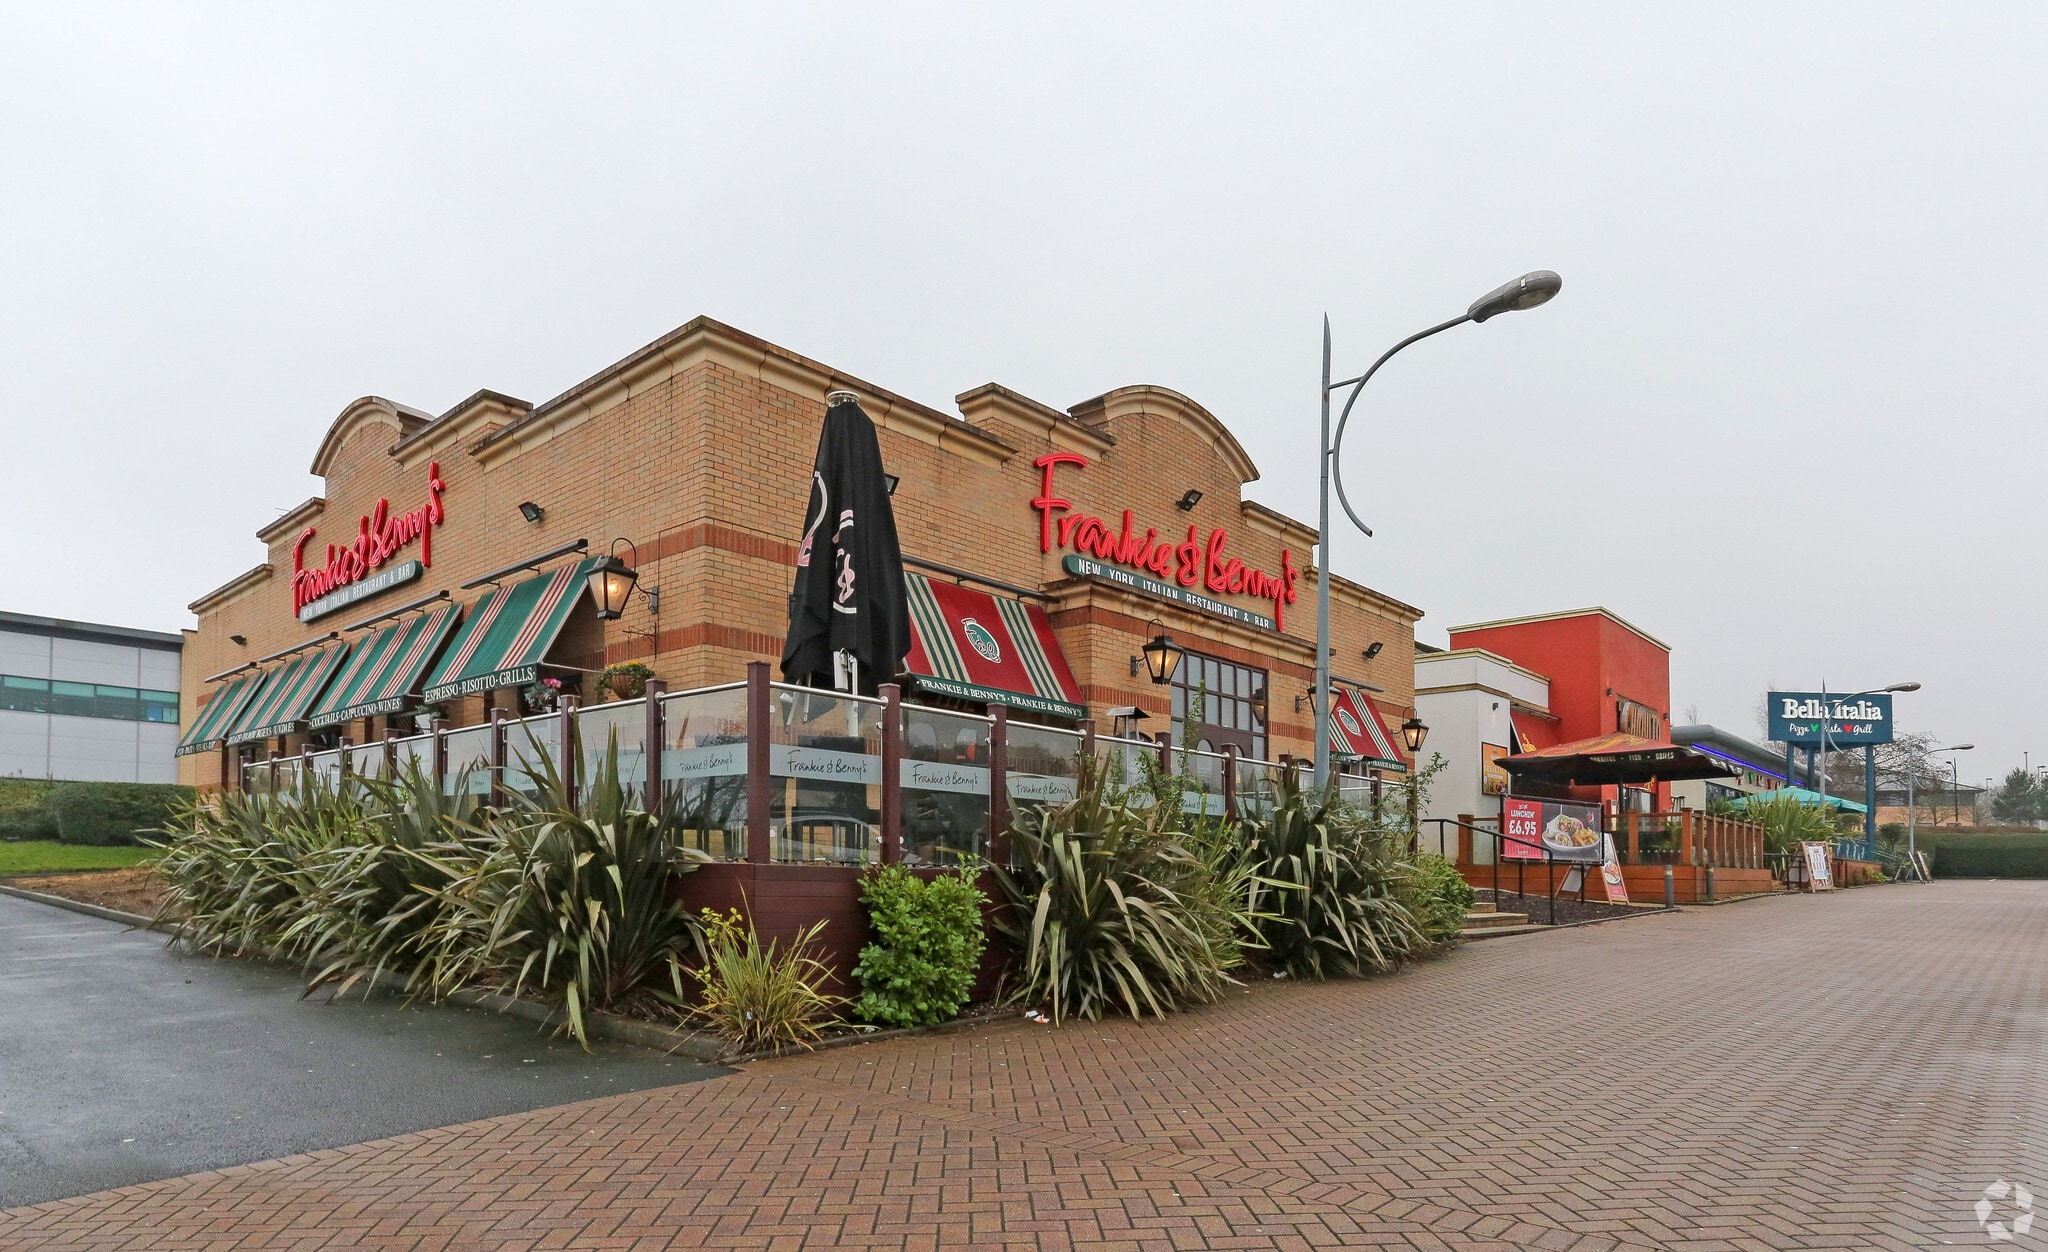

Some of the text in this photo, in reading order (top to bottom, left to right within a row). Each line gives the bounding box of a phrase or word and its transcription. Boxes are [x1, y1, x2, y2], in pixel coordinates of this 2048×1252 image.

[291, 528, 354, 618] Frankie
[369, 462, 445, 568] Benny's
[1031, 453, 1172, 577] Frankie
[1204, 528, 1298, 632] Benny's
[302, 608, 313, 618] NEW
[330, 590, 349, 608] ITALIAN
[352, 573, 387, 598] RESTAURANT
[398, 564, 410, 580] BAR
[1078, 559, 1270, 628] NEW YORK ITALIAN RESTAURANT & BAR
[424, 668, 533, 703] ESPRESSO RISOTTO GRILLS
[920, 678, 962, 694] FRANKIE
[970, 689, 1007, 702] BENNY'S
[1011, 696, 1047, 710] FRANKIE
[1054, 705, 1083, 716] BENNY'S
[311, 710, 340, 728] COCKTAILS
[377, 698, 401, 712] WINES
[1781, 698, 1883, 720] Bella Italia
[1789, 722, 1810, 736] Pizza
[1853, 723, 1874, 735] Grill
[787, 750, 825, 773] Frankie
[835, 758, 867, 780] Benny's
[912, 763, 943, 784] Frankie
[952, 772, 978, 790] Benny's
[1508, 819, 1537, 836] £6.95
